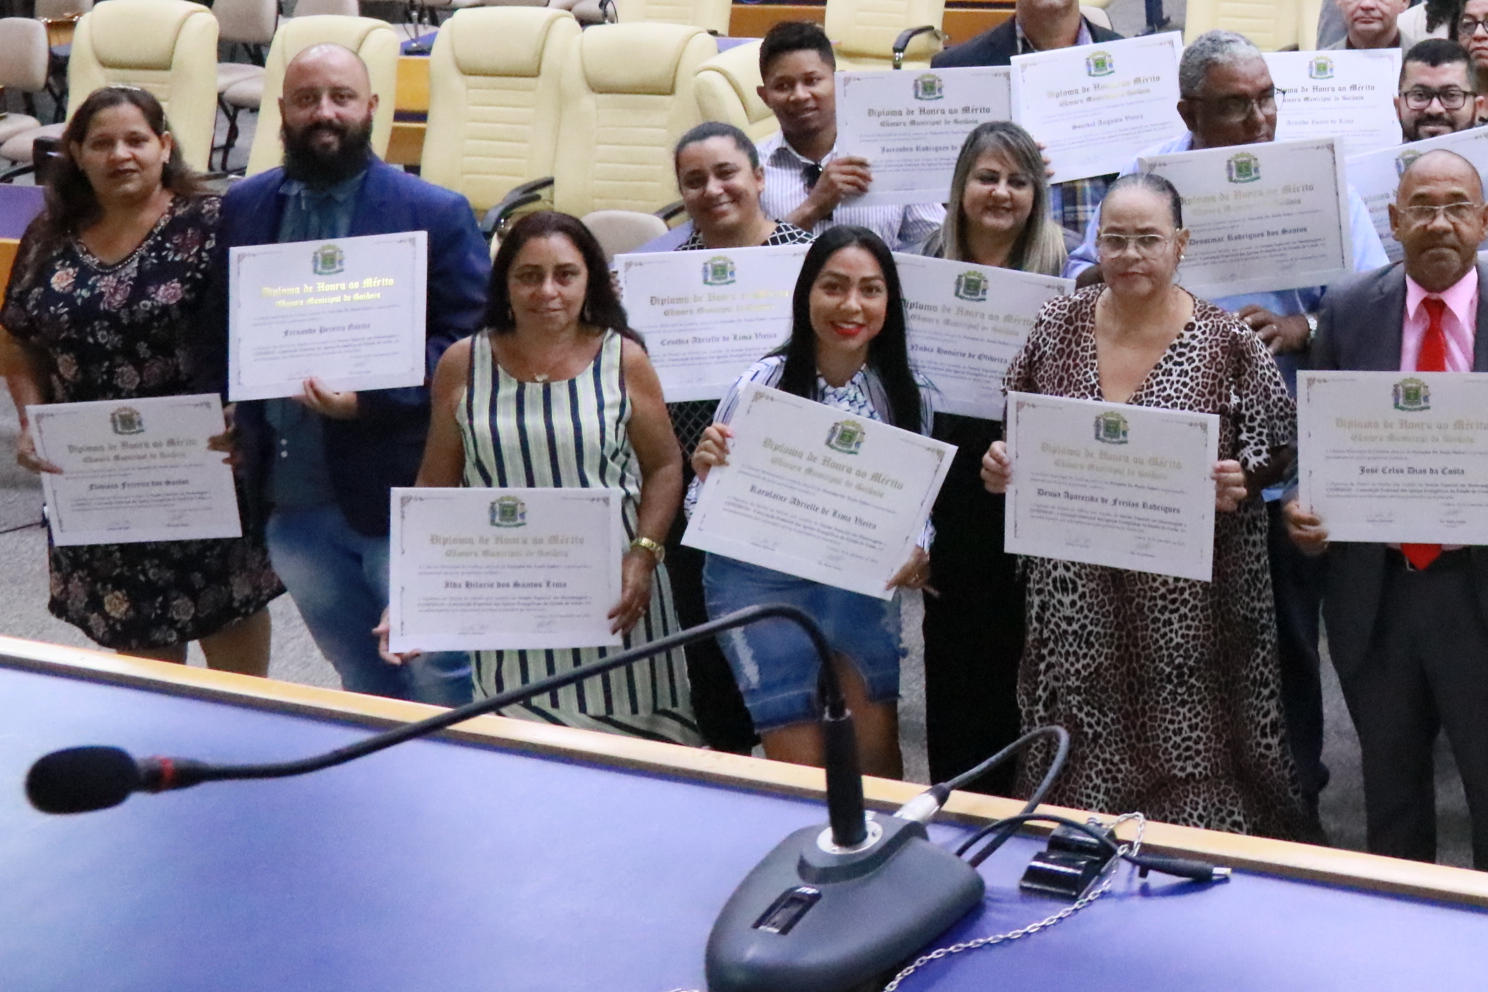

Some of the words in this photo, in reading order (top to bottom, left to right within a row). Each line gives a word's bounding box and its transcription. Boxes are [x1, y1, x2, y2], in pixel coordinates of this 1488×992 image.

[868, 109, 902, 118] Diploma
[961, 105, 990, 114] Mérito
[1281, 227, 1307, 235] Santos
[1441, 467, 1464, 475] Costa
